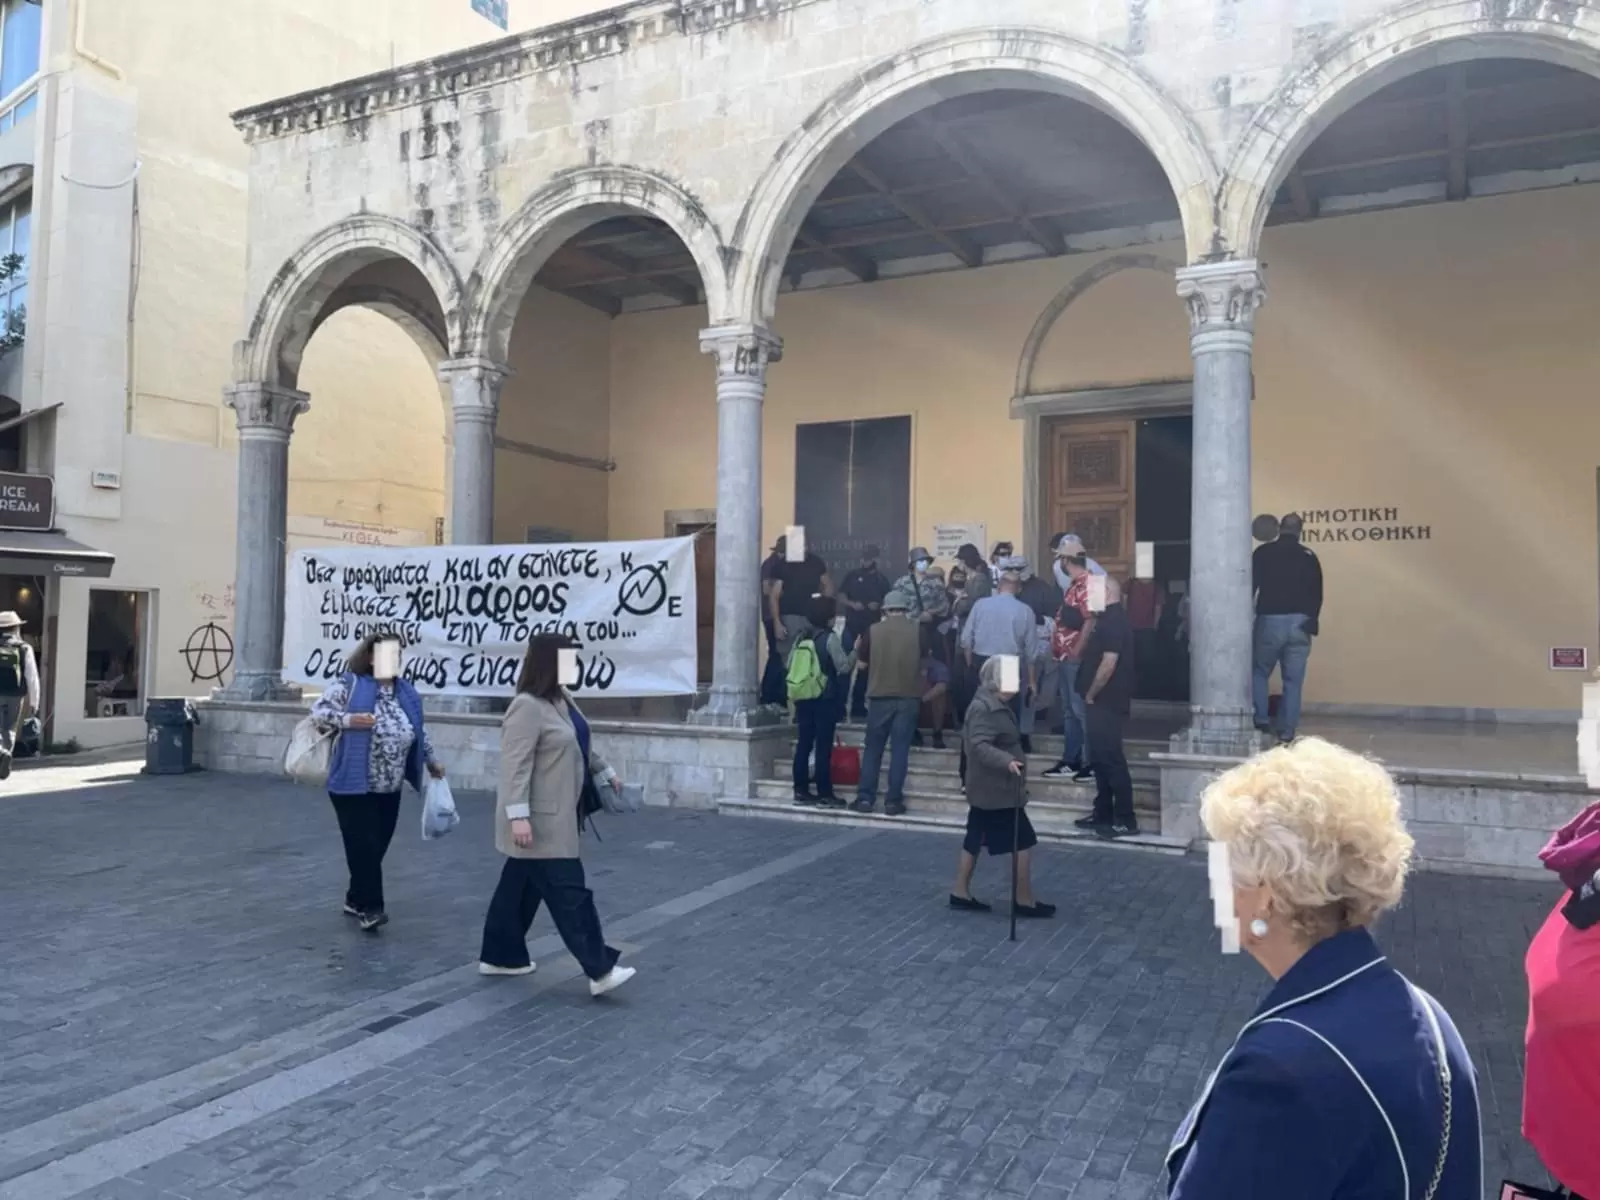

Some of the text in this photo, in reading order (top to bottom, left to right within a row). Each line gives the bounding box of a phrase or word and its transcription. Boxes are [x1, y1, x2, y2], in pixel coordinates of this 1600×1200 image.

[2, 486, 27, 498] ICE
[1300, 507, 1398, 524] ΗΜΟΤΙΚΗ
[1301, 525, 1431, 543] ΙΝΑΚΟΘΗΚΗ
[343, 561, 430, 594] φράγματα
[447, 621, 488, 647] την
